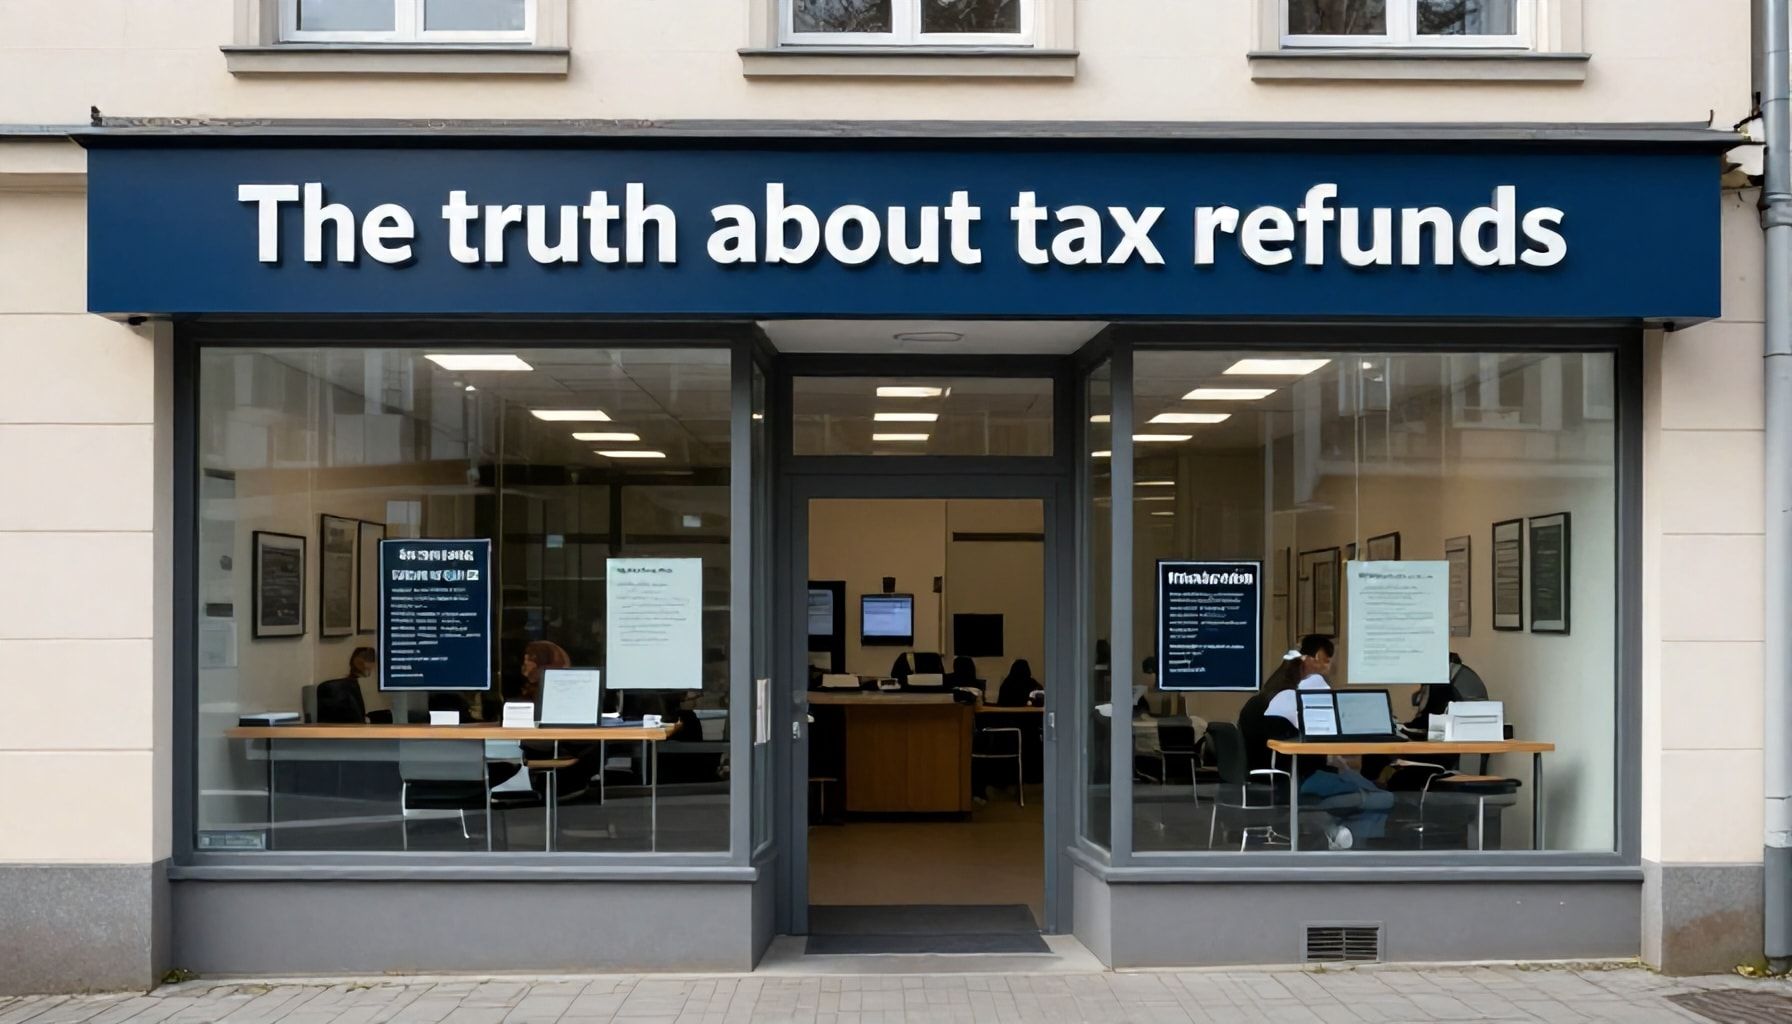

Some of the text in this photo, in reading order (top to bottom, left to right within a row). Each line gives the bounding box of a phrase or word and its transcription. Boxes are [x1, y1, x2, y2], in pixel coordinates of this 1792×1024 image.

[237, 183, 1567, 267] The truth about tax refunds
